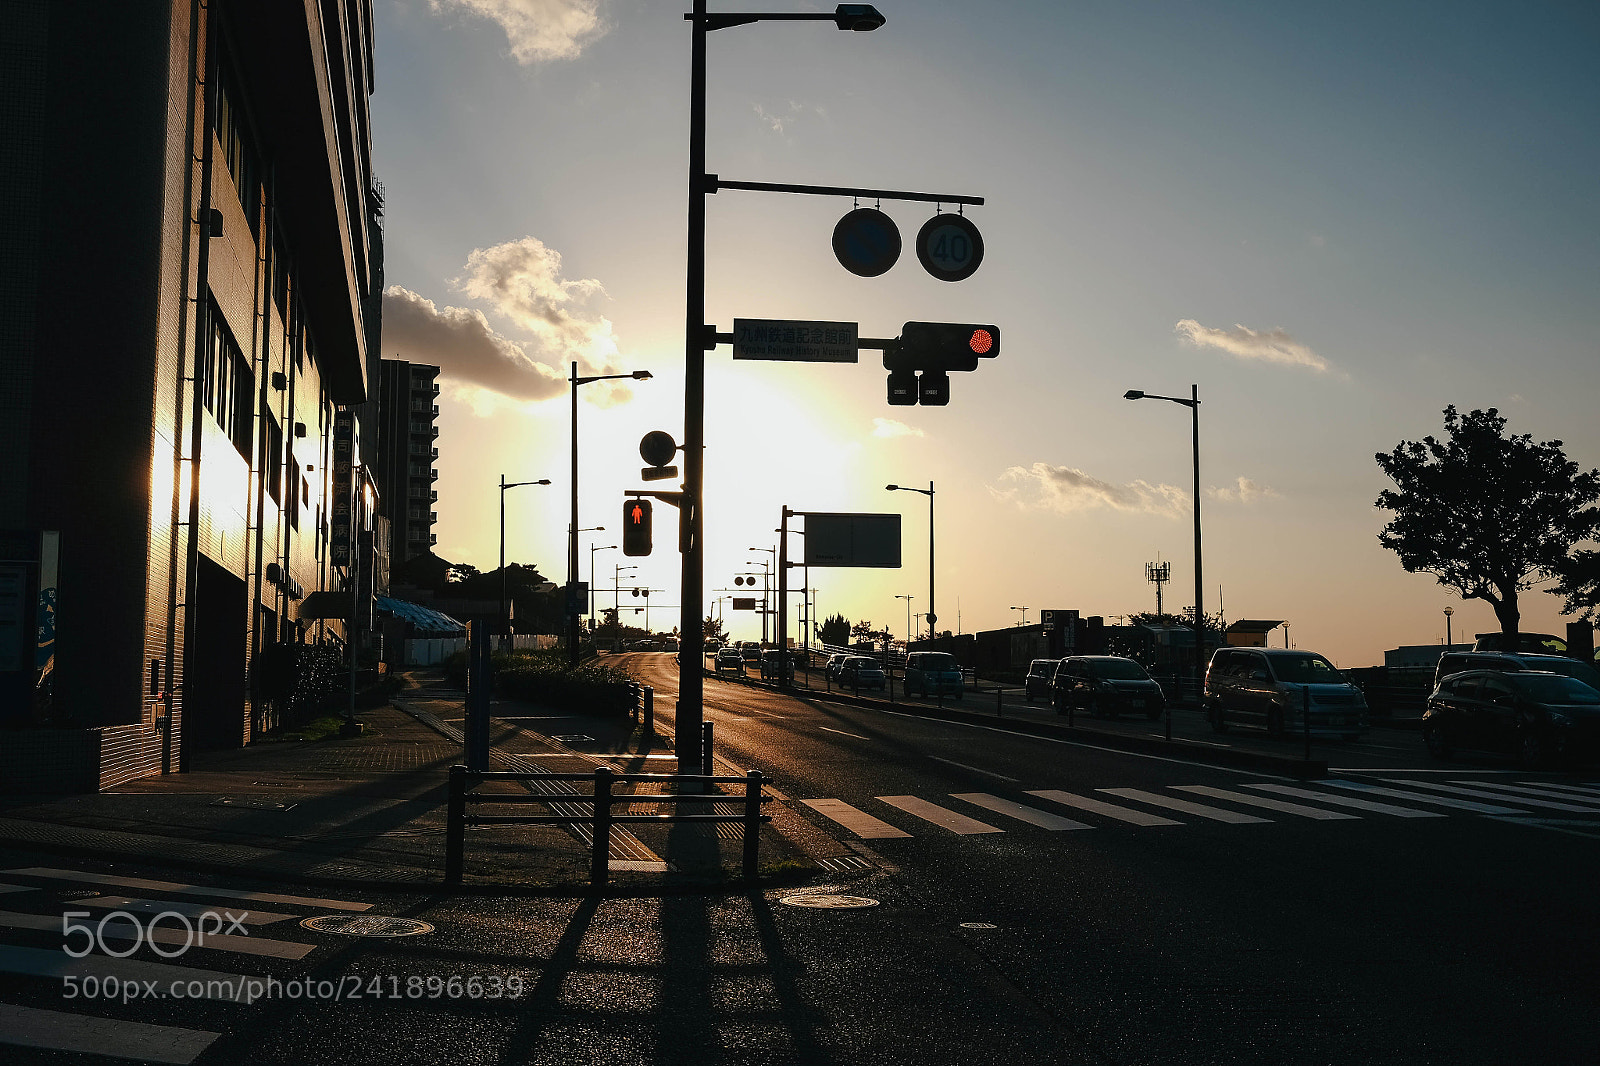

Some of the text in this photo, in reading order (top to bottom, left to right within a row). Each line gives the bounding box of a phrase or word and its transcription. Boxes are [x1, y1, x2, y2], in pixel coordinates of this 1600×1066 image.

[933, 233, 968, 263] 40
[740, 326, 851, 344] 九州鉄道記念館前
[767, 345, 793, 357] Railway
[796, 346, 820, 357] History
[822, 347, 851, 357] Museum
[1045, 611, 1053, 622] P
